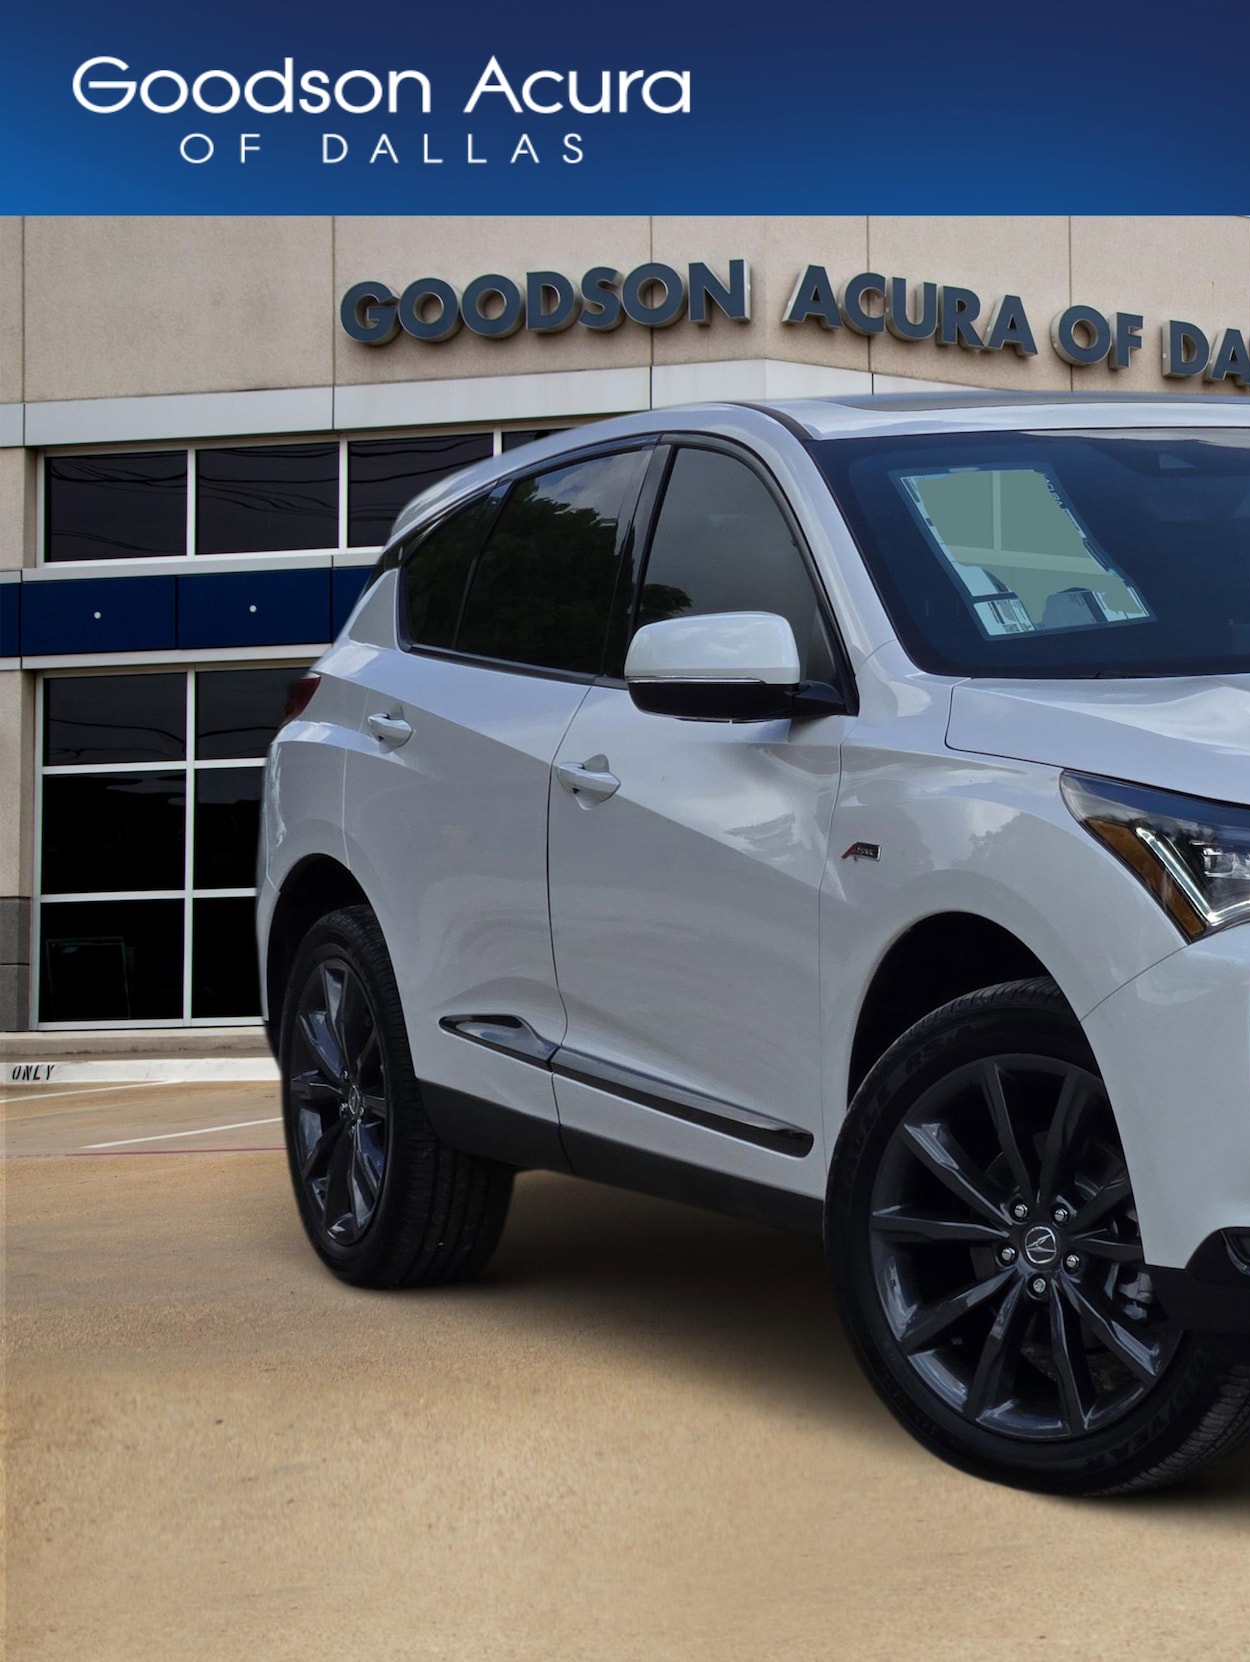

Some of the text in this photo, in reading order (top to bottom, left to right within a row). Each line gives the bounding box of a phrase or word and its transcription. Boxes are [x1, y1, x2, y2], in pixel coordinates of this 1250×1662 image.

[340, 259, 751, 346] GOODSON
[783, 264, 1038, 356] ACURA
[1051, 305, 1143, 369] OF
[11, 1064, 55, 1080] ONLY
